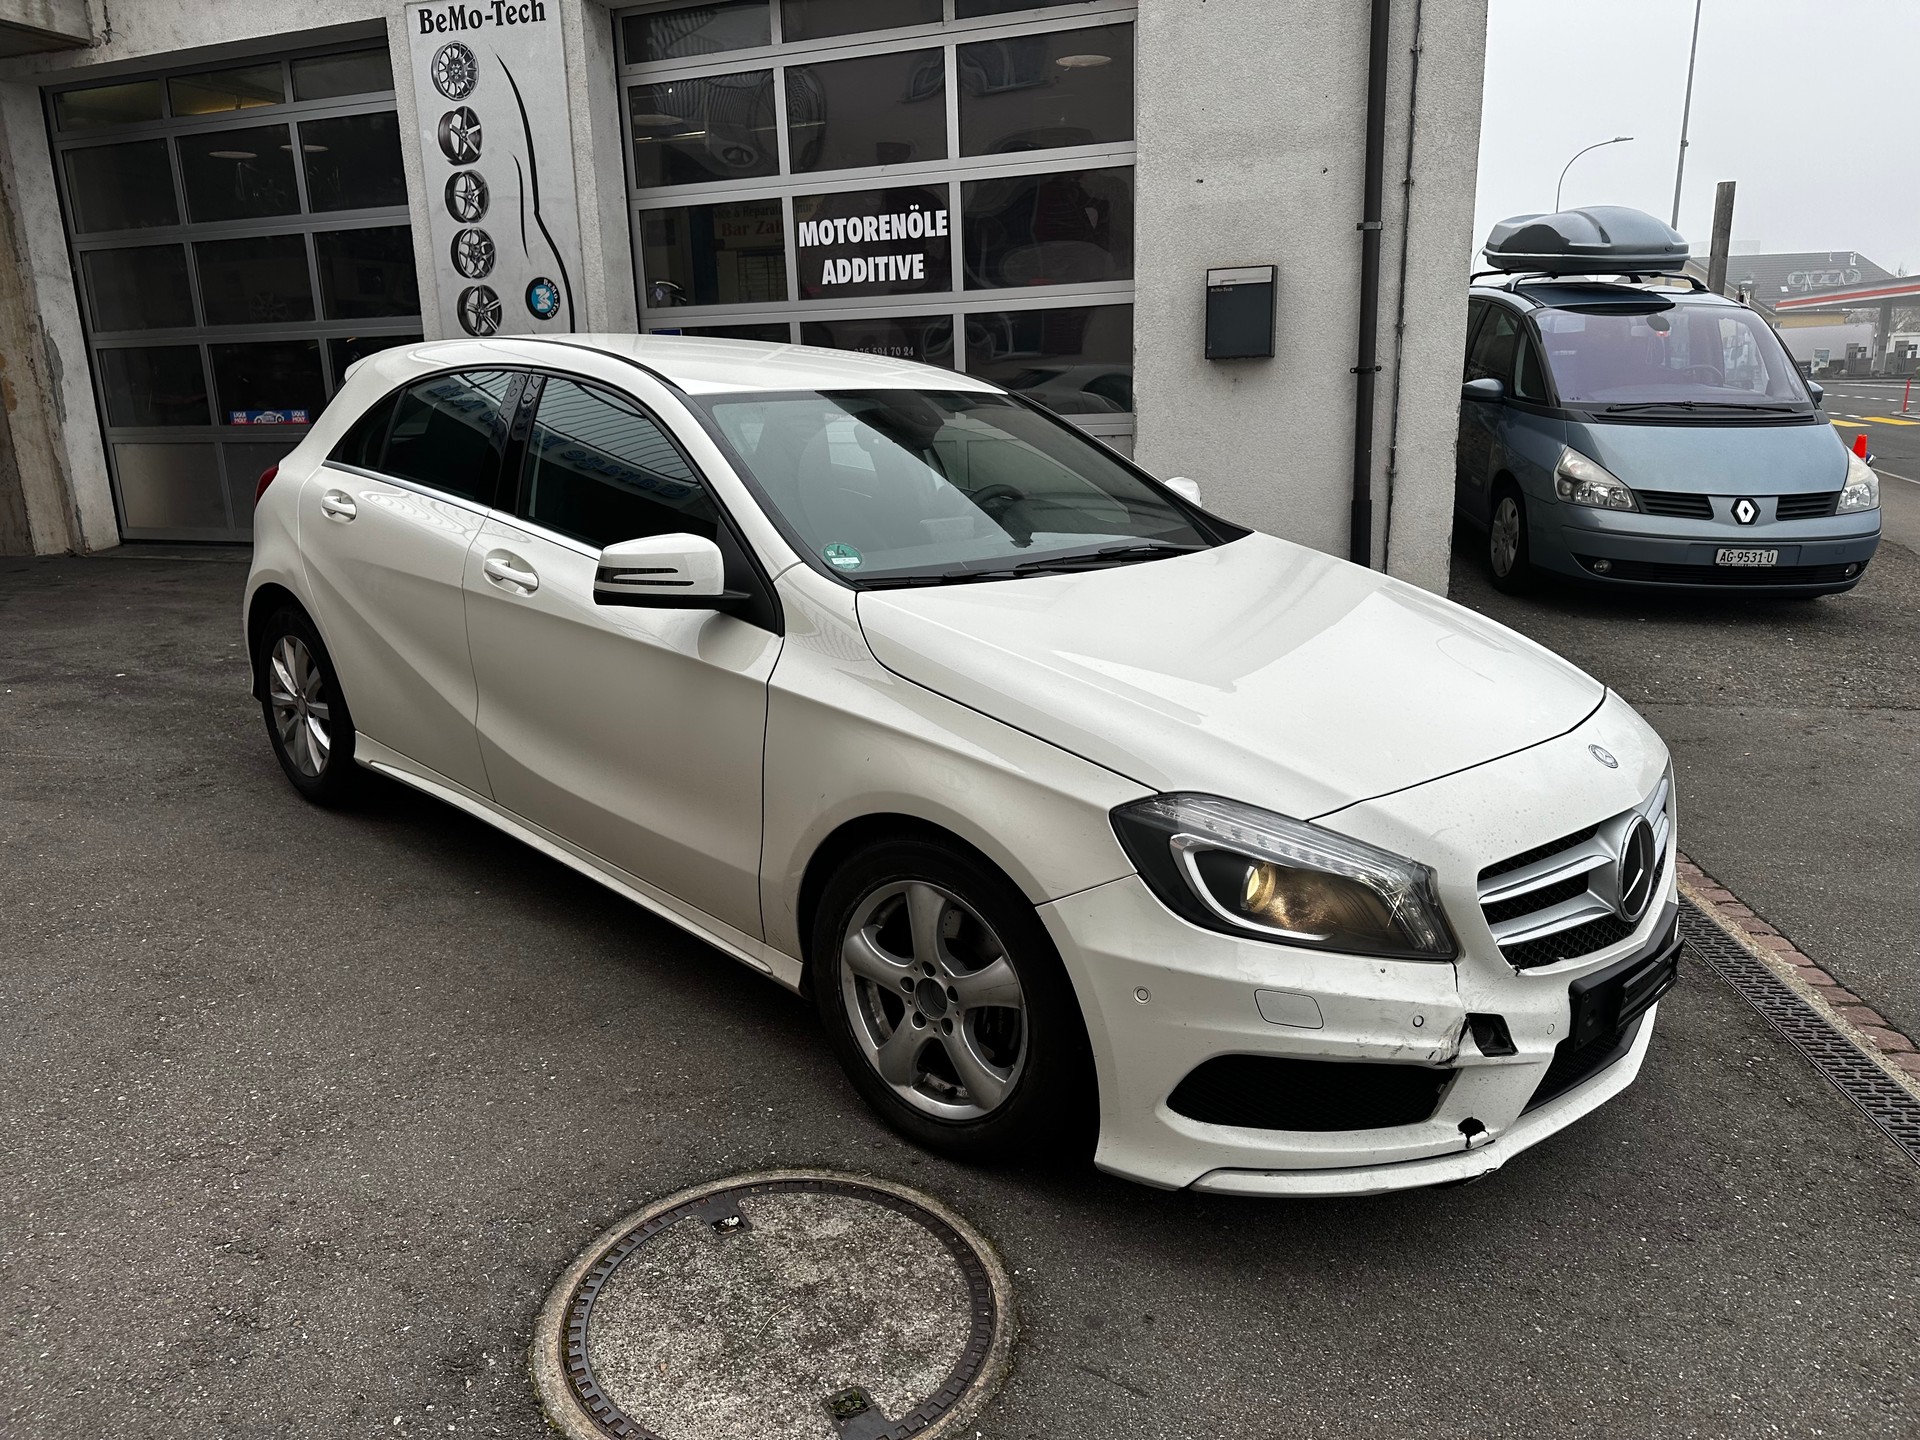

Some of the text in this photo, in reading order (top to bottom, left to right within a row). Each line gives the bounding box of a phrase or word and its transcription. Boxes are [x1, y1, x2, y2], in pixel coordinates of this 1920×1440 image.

[418, 0, 546, 34] BeMo-Tech
[799, 204, 948, 247] MOTORENÖLE
[821, 253, 925, 285] ADDITIVE
[890, 346, 901, 356] 70
[903, 346, 914, 356] 24
